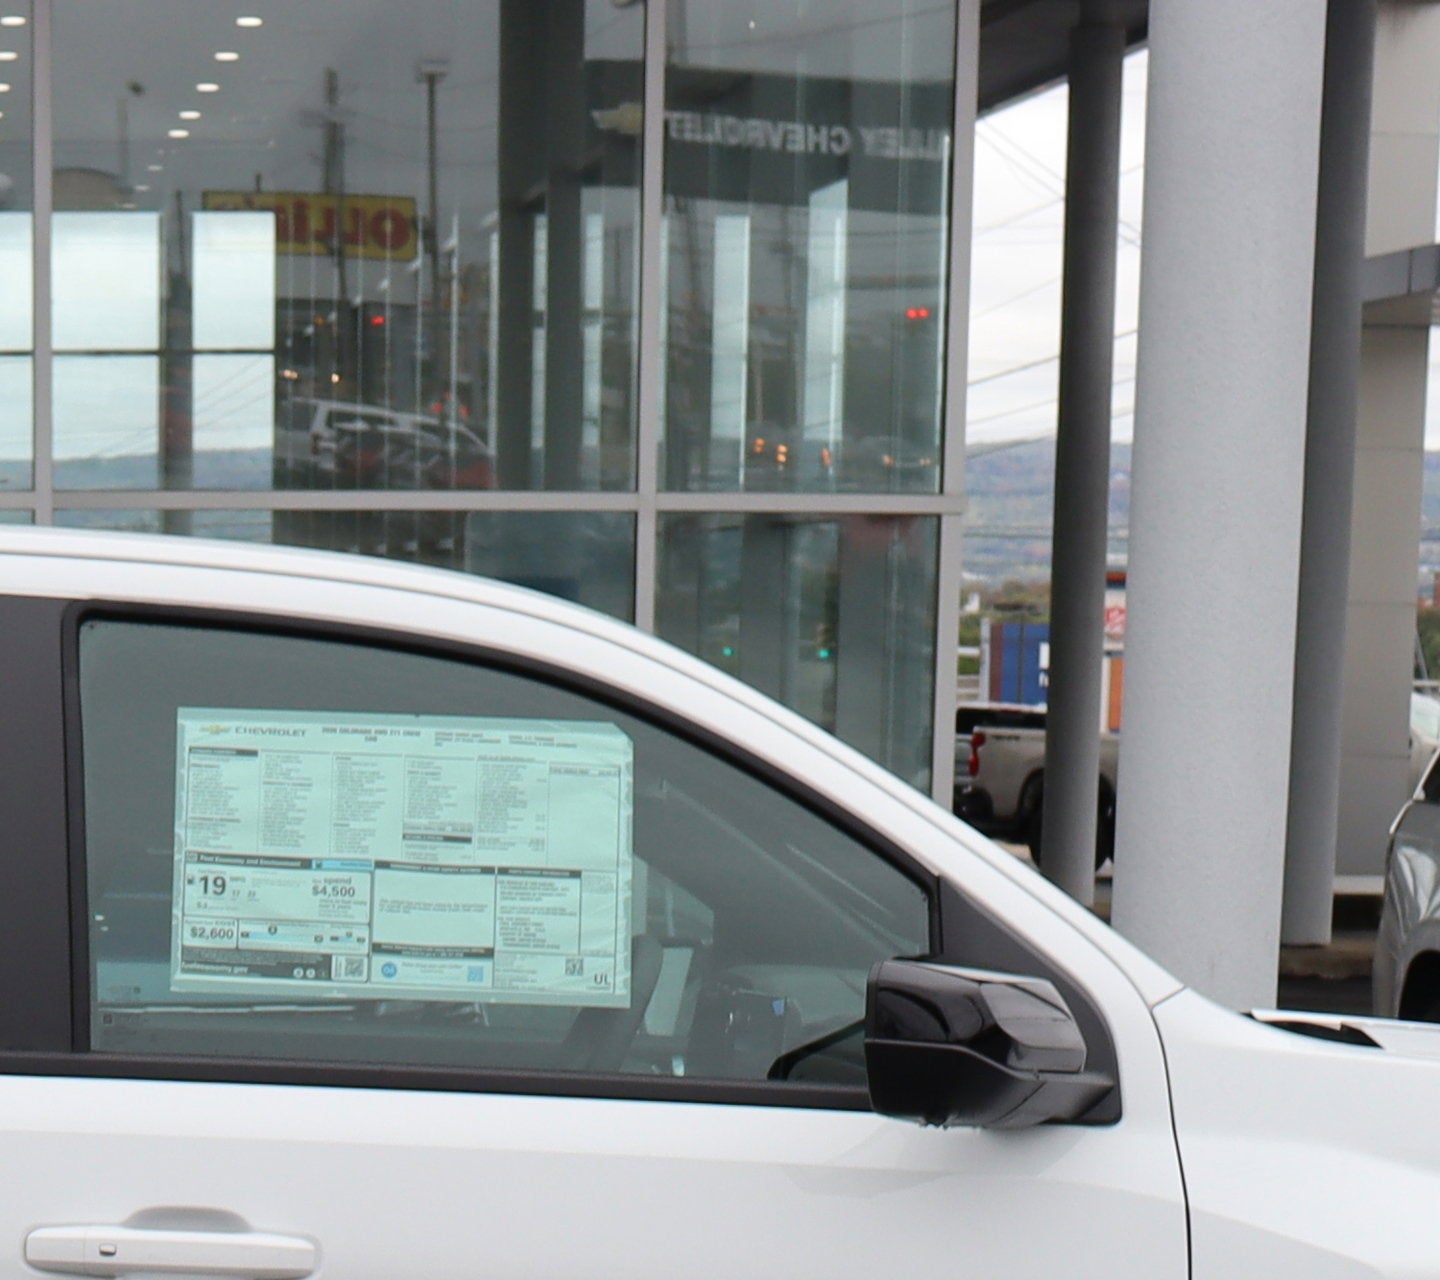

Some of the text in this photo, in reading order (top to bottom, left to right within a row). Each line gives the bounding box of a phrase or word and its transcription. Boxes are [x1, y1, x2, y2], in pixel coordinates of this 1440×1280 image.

[235, 726, 307, 738] CHEVROLET
[199, 875, 227, 896] 19
[312, 885, 356, 899] $4,500
[190, 926, 234, 941] $2,600
